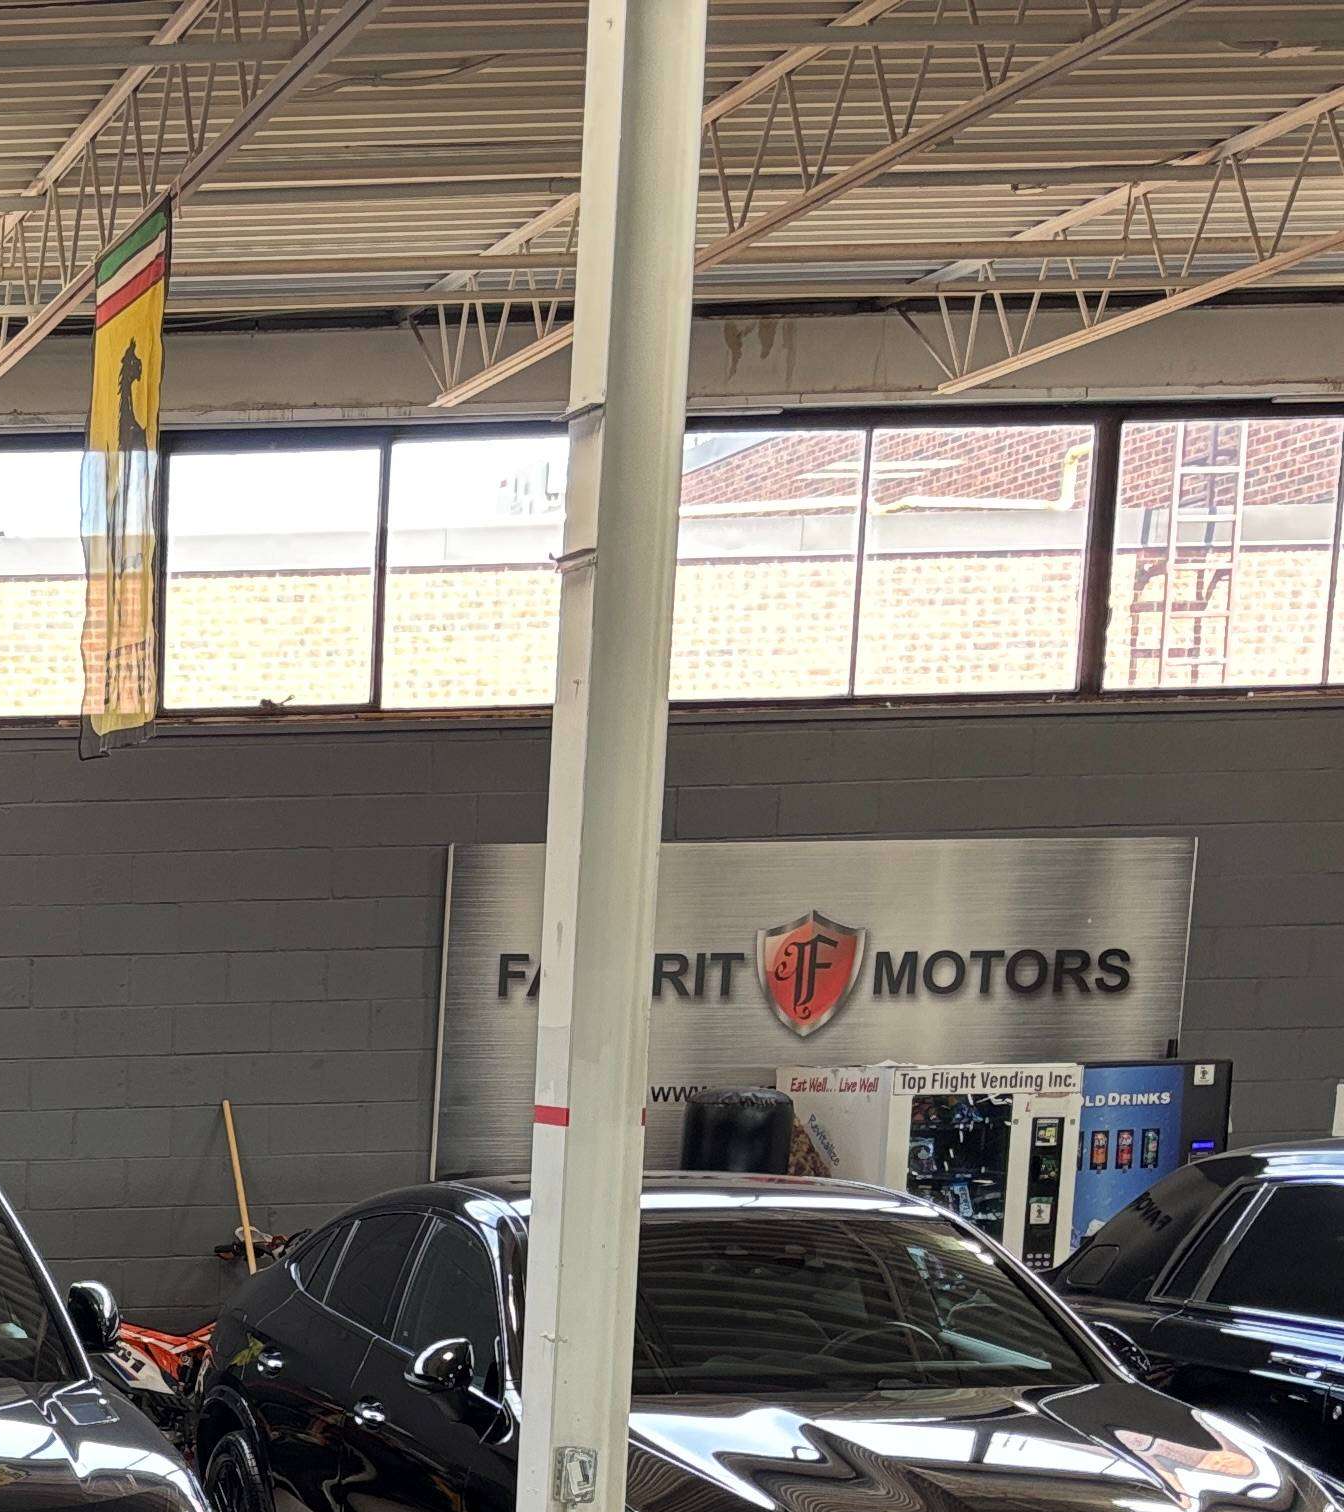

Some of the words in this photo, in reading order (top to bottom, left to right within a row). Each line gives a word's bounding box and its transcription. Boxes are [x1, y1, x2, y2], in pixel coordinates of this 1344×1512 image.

[499, 953, 744, 998] FRIT
[872, 948, 1132, 996] MOTORS
[790, 1077, 809, 1093] Eat
[838, 1077, 858, 1093] Live
[859, 1076, 879, 1093] Well
[900, 1072, 926, 1093] Top
[931, 1072, 976, 1093] Flight
[980, 1071, 1043, 1092] Vending
[1048, 1071, 1077, 1088] Inc.
[1079, 1094, 1106, 1107] LD
[1107, 1092, 1171, 1107] DRINKS
[806, 1113, 841, 1167] Revitalize
